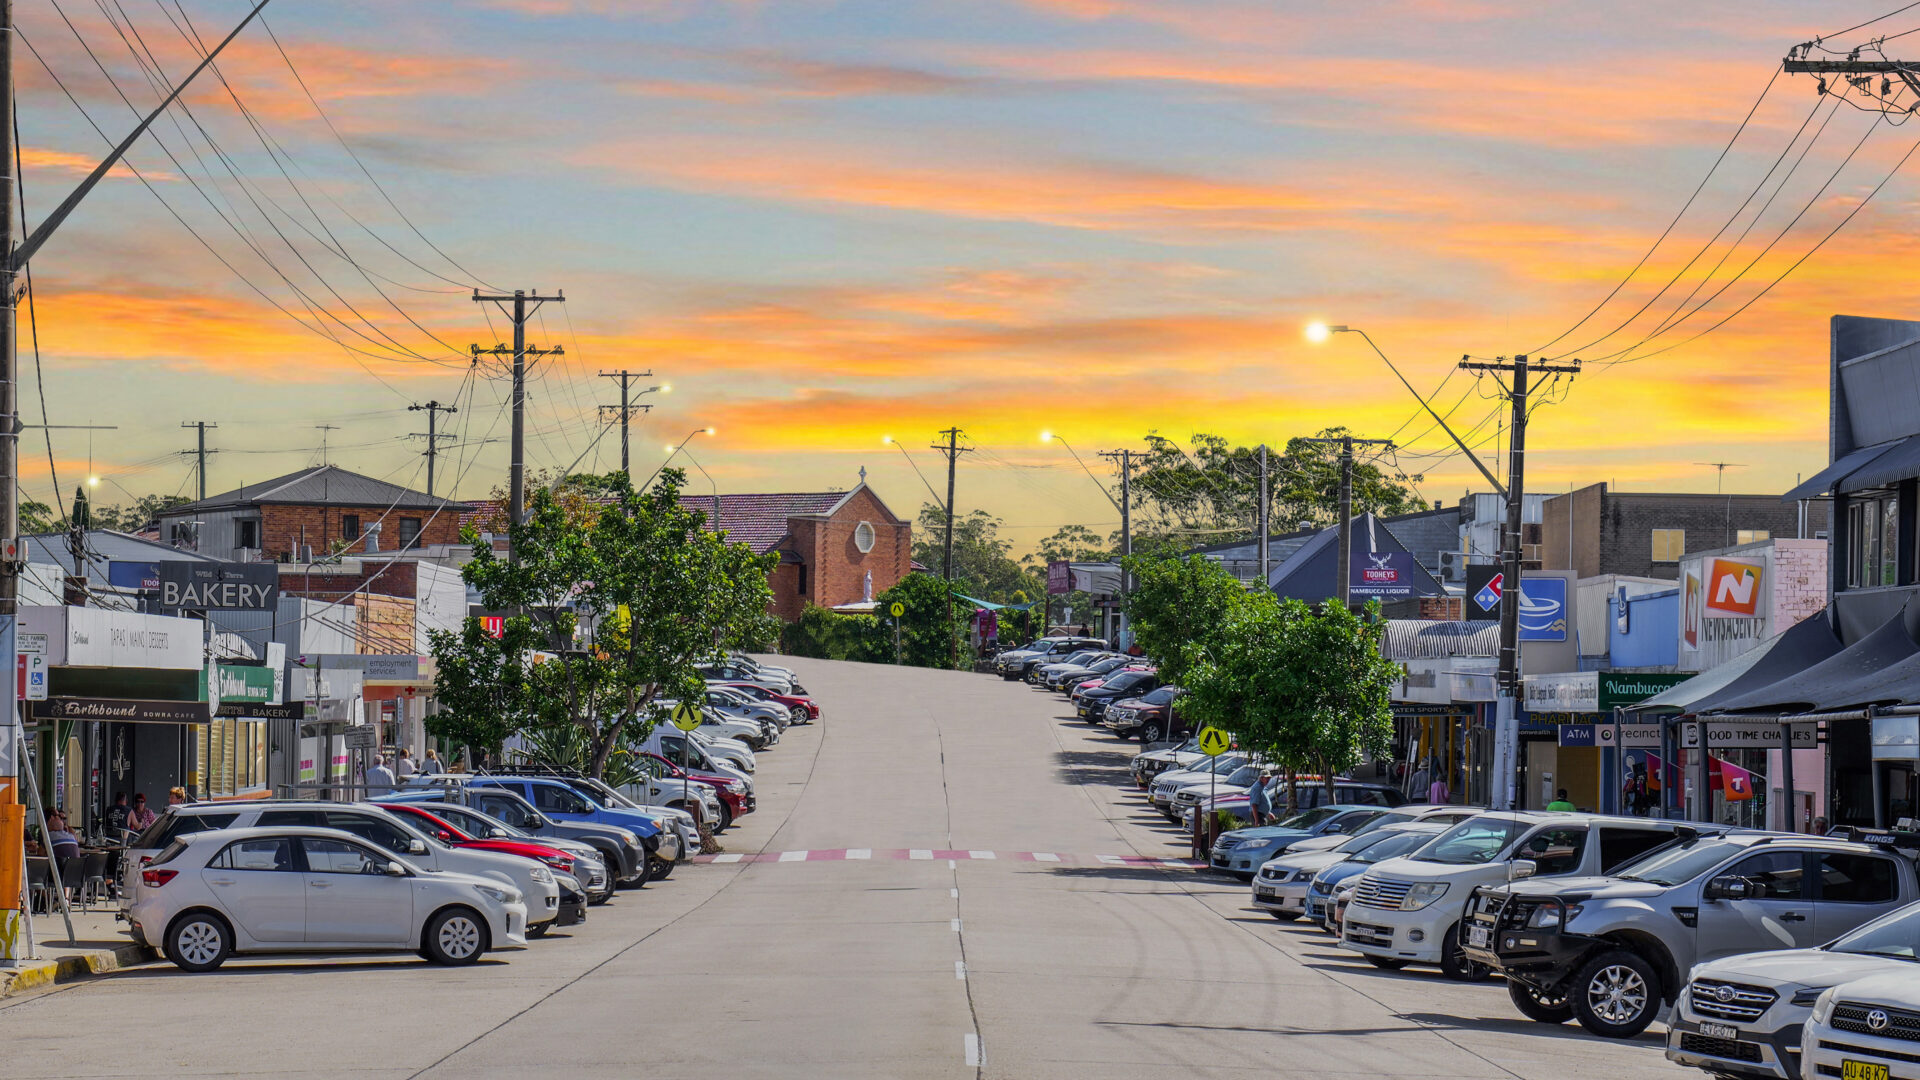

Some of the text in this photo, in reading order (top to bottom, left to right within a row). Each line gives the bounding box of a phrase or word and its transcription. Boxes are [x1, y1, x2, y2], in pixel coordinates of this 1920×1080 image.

[1366, 570, 1395, 578] TOOHEYS
[163, 581, 273, 608] BAKERY
[110, 628, 126, 647] TAPAS
[129, 630, 145, 648] MAINS
[148, 631, 169, 650] DESSERTS
[33, 657, 42, 669] P
[369, 659, 412, 668] employment
[1605, 680, 1671, 694] Nambucca
[64, 701, 137, 717] Earthbound
[252, 708, 291, 717] BAKERY
[1530, 713, 1606, 725] PHARMACY
[1566, 729, 1590, 739] ATM
[1614, 729, 1661, 741] recinct
[1707, 730, 1811, 741] OOD TIME CHAIE'S
[1732, 777, 1744, 791] T
[1863, 833, 1896, 844] KINGS
